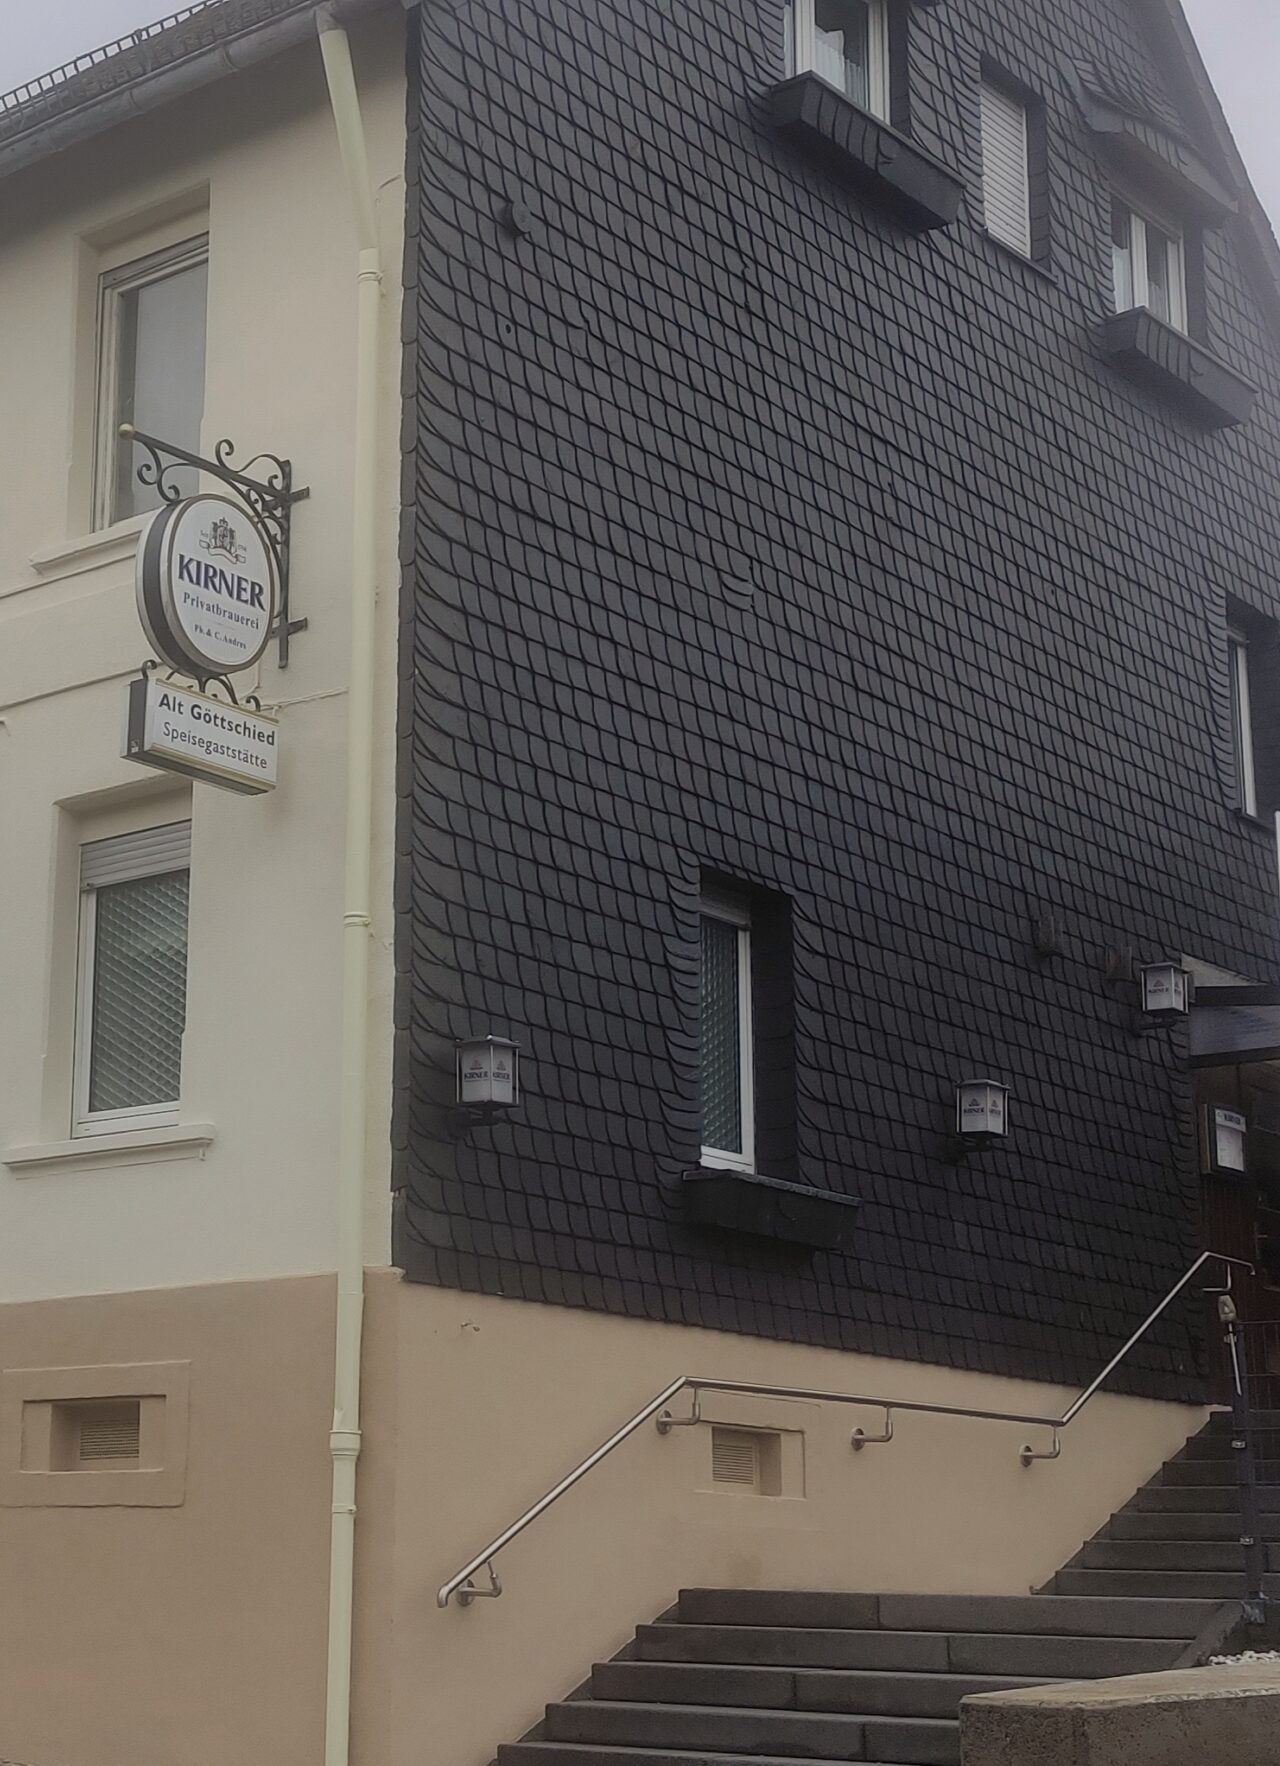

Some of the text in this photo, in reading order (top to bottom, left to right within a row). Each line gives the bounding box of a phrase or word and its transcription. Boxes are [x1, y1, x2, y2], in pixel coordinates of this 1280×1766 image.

[178, 553, 266, 612] KIRNER
[183, 592, 260, 630] Privatbrauerei
[159, 693, 276, 746] Alt Göttschied
[163, 721, 268, 769] Speisegaststätte
